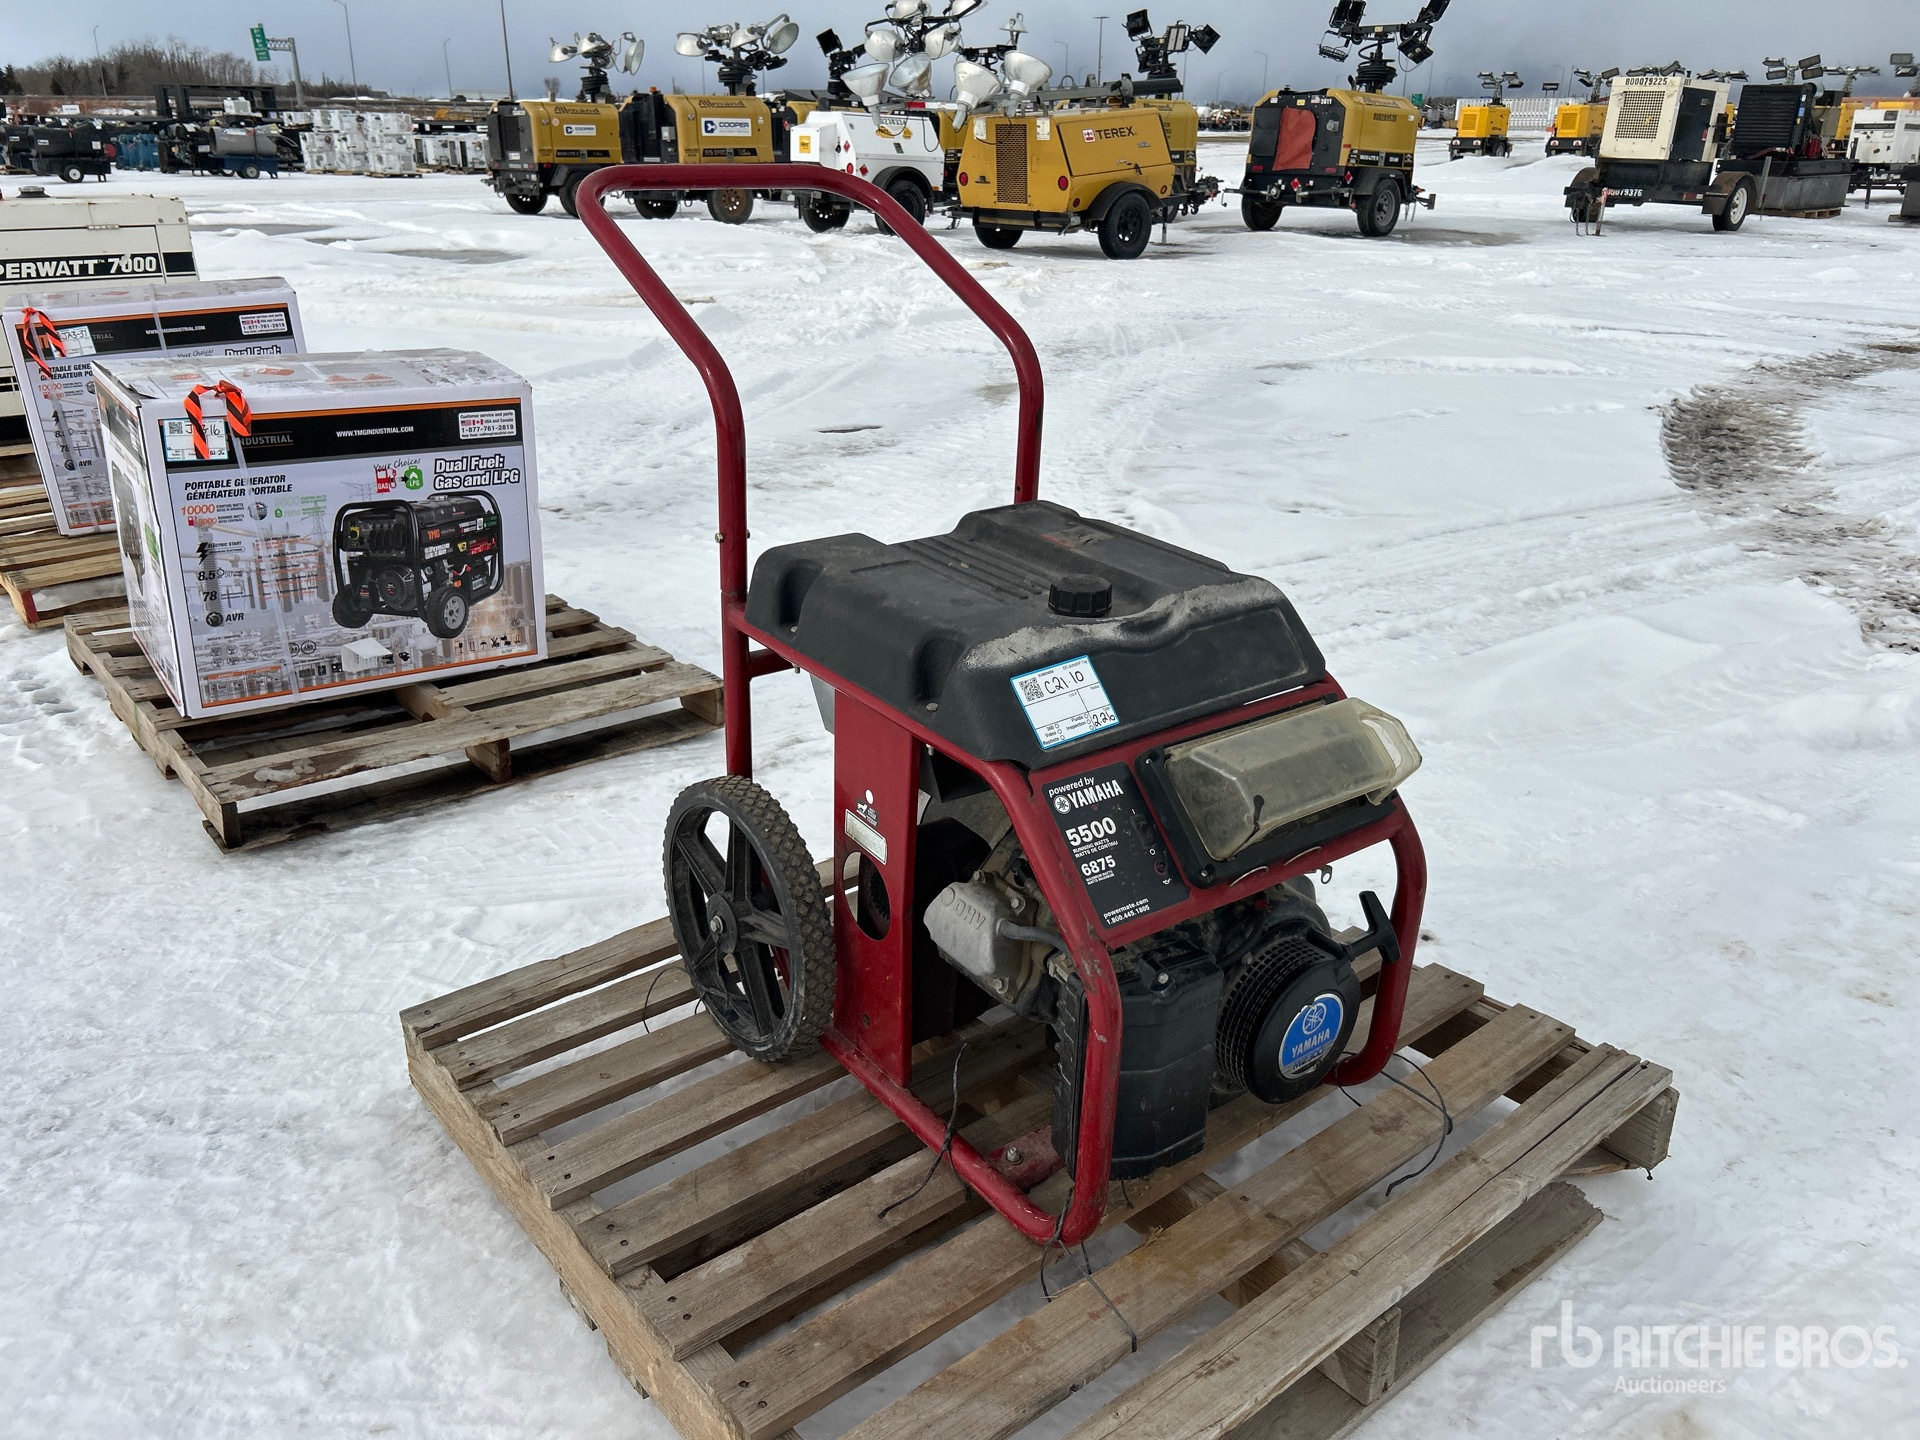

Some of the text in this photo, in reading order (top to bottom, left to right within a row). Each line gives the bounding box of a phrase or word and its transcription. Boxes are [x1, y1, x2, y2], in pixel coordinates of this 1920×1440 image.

[1625, 78, 1668, 86] 800079225
[1096, 126, 1134, 140] TEREX
[108, 256, 157, 274] 7000
[336, 426, 414, 438] WWW.TMGINDUSTRIAL.COM
[462, 424, 514, 433] 1-877-761-2819
[394, 458, 421, 468] Choice!
[434, 454, 504, 474] Dual Fuel:
[184, 479, 232, 490] PORTABLE
[434, 469, 520, 490] Gas and LPG
[186, 488, 246, 500] GÉNÉRATEUR
[181, 504, 215, 515] 10000
[198, 570, 216, 581] 8.5
[203, 590, 217, 602] 78
[226, 613, 244, 622] AVR
[1066, 721, 1086, 731] Inspection
[1048, 776, 1095, 798] powered by
[1067, 779, 1124, 809] YAMAHA
[1066, 816, 1116, 846] 5500
[1075, 850, 1091, 858] WATTS
[1081, 855, 1116, 876] 6875
[1104, 898, 1148, 919] powermate.com
[1292, 1028, 1330, 1058] YAMAHA
